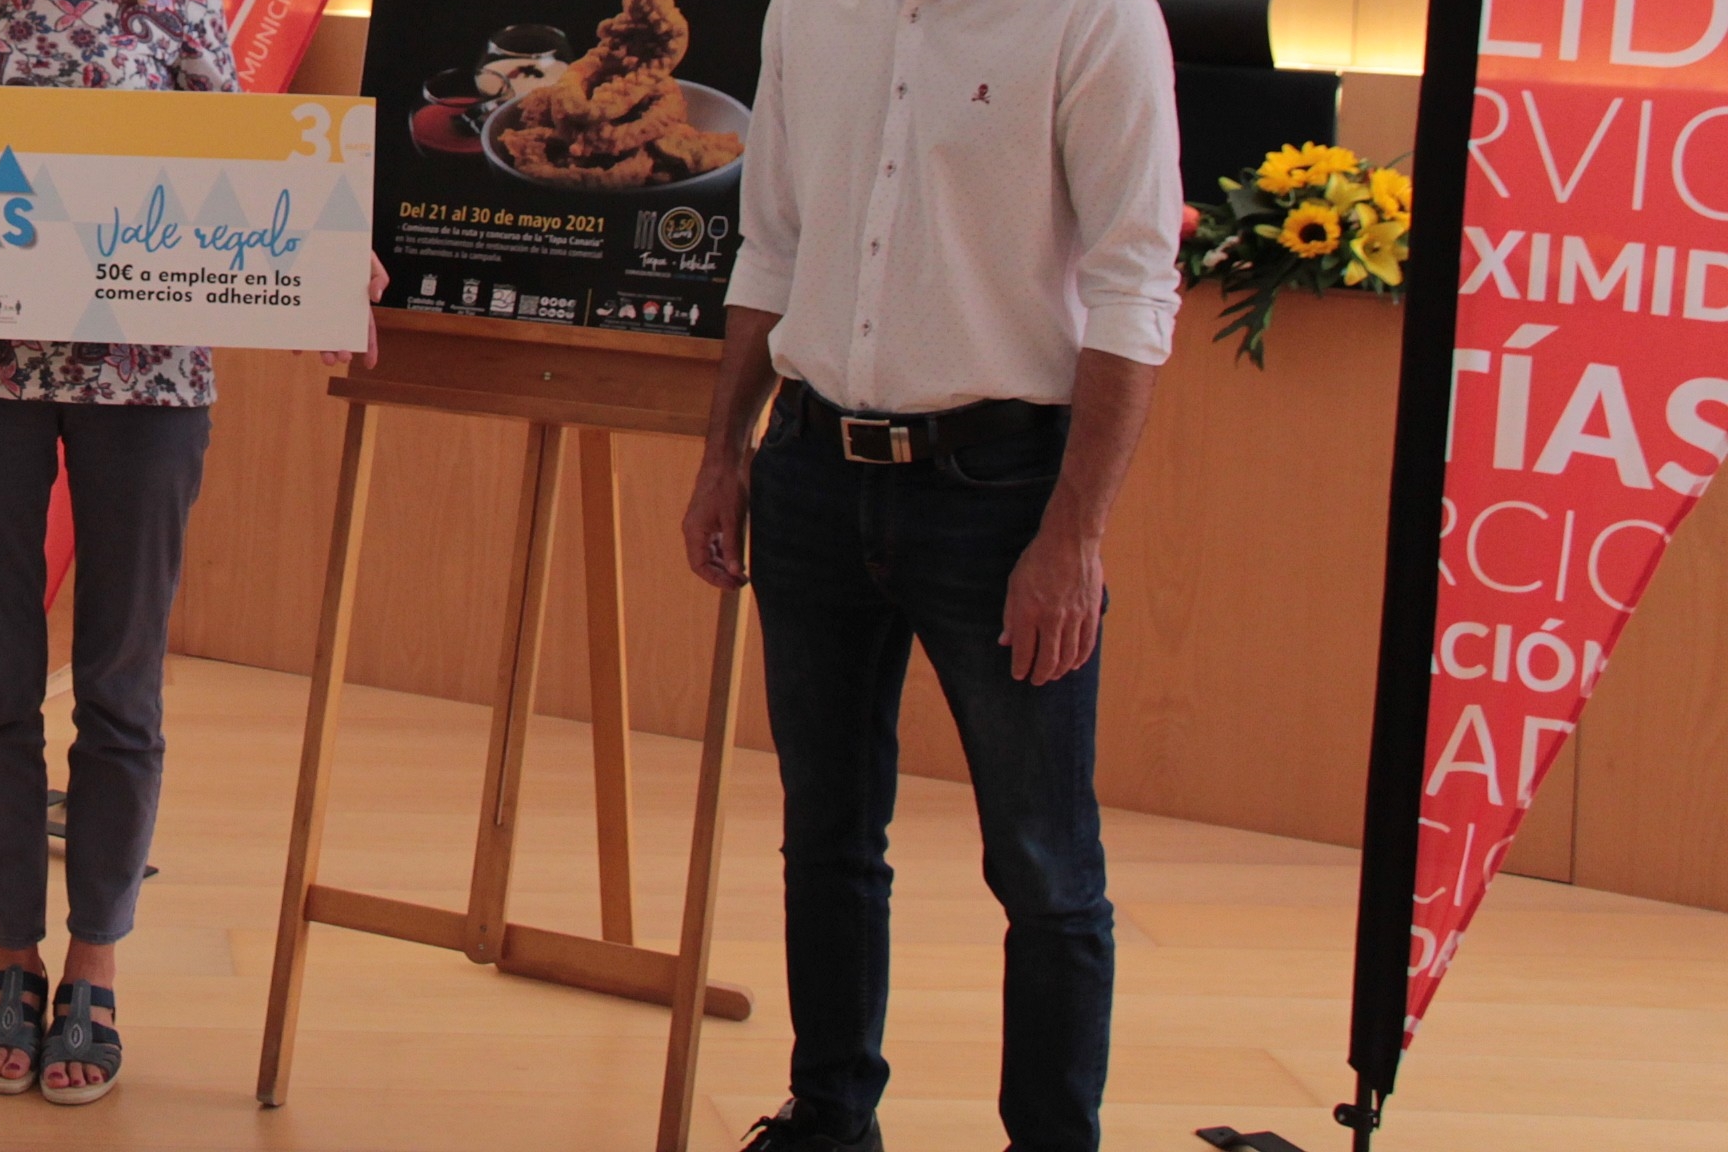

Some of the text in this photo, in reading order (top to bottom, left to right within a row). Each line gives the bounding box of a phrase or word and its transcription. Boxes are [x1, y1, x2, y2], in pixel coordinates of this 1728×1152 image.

[97, 184, 302, 271] Vale regalo
[399, 201, 605, 233] Del 21 al 30 de mayo 2021
[96, 263, 301, 287] 50€ a emplear en los
[94, 286, 301, 306] comercios adheridos
